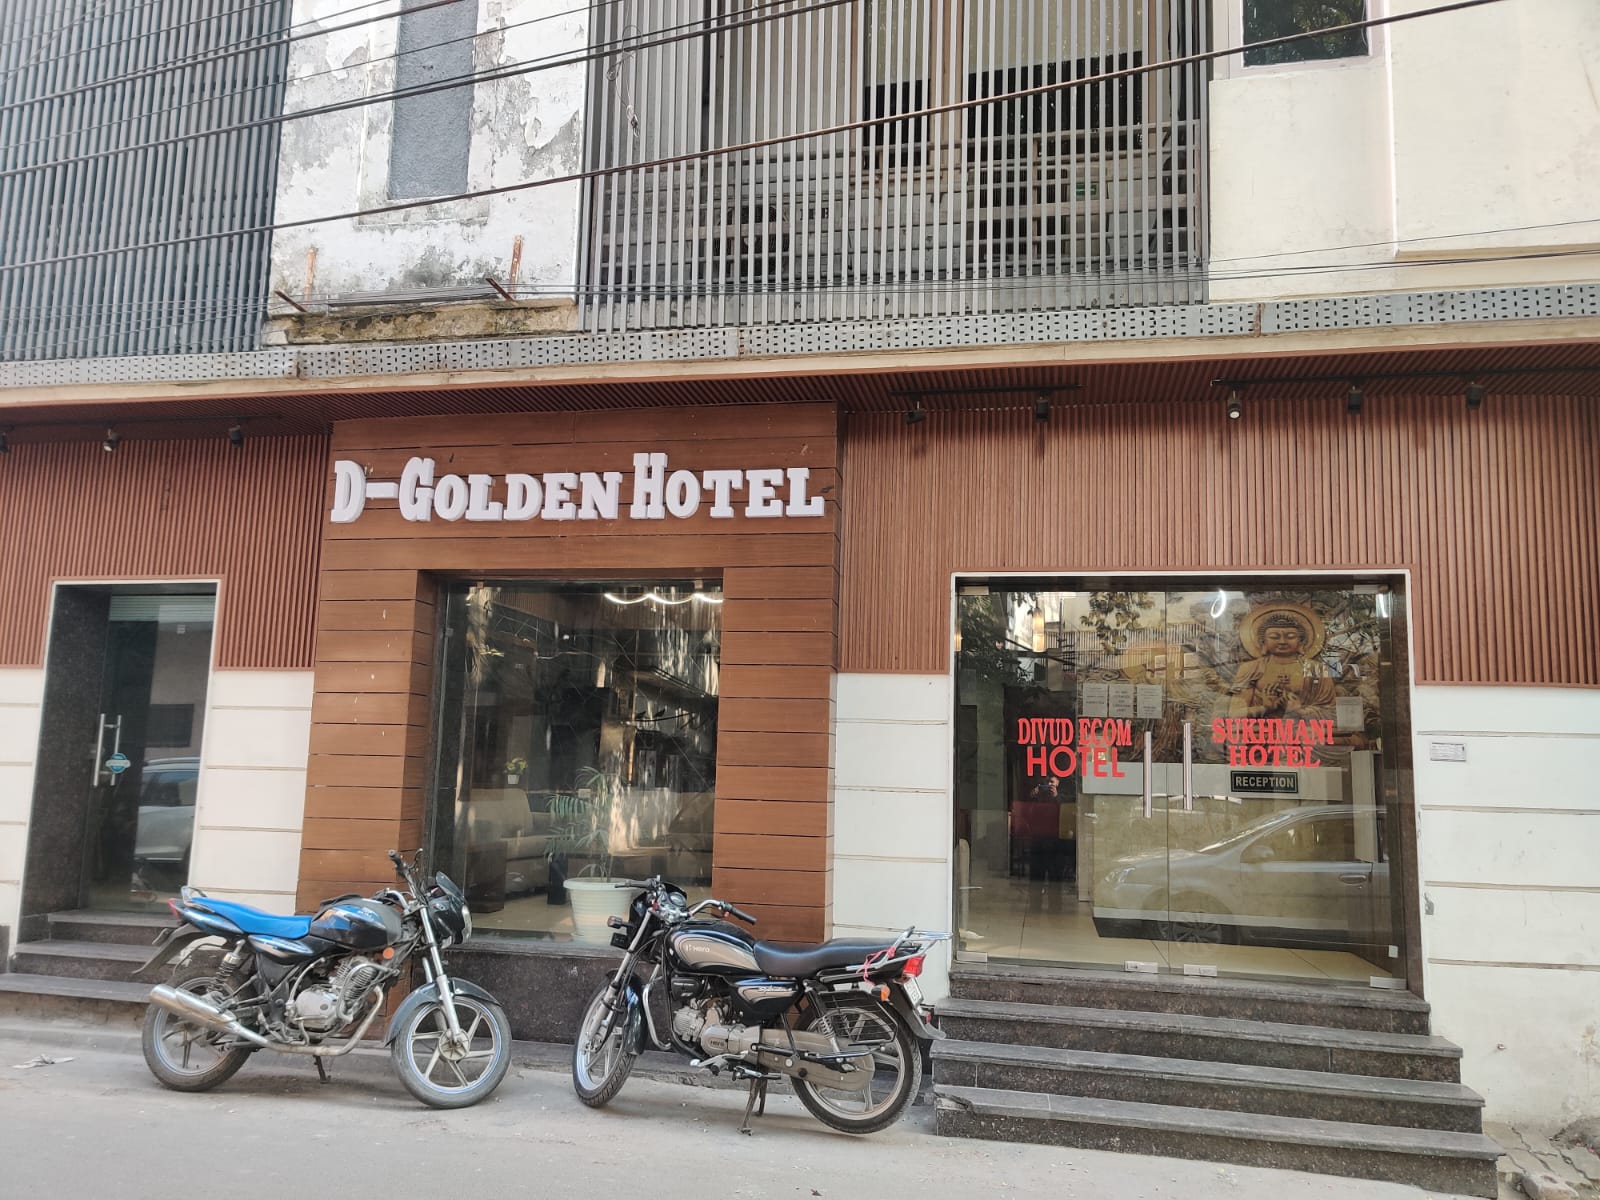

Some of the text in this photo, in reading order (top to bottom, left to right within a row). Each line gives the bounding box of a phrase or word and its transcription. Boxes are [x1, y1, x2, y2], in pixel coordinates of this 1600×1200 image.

[330, 452, 825, 523] D-GOLDEN HOTEL
[1017, 717, 1133, 746] DIVUD ECOM
[1211, 717, 1335, 745] SUKHMANI
[1026, 745, 1126, 778] HOTEL
[1228, 744, 1322, 768] HOTEL
[1235, 776, 1295, 788] RECEPTION
